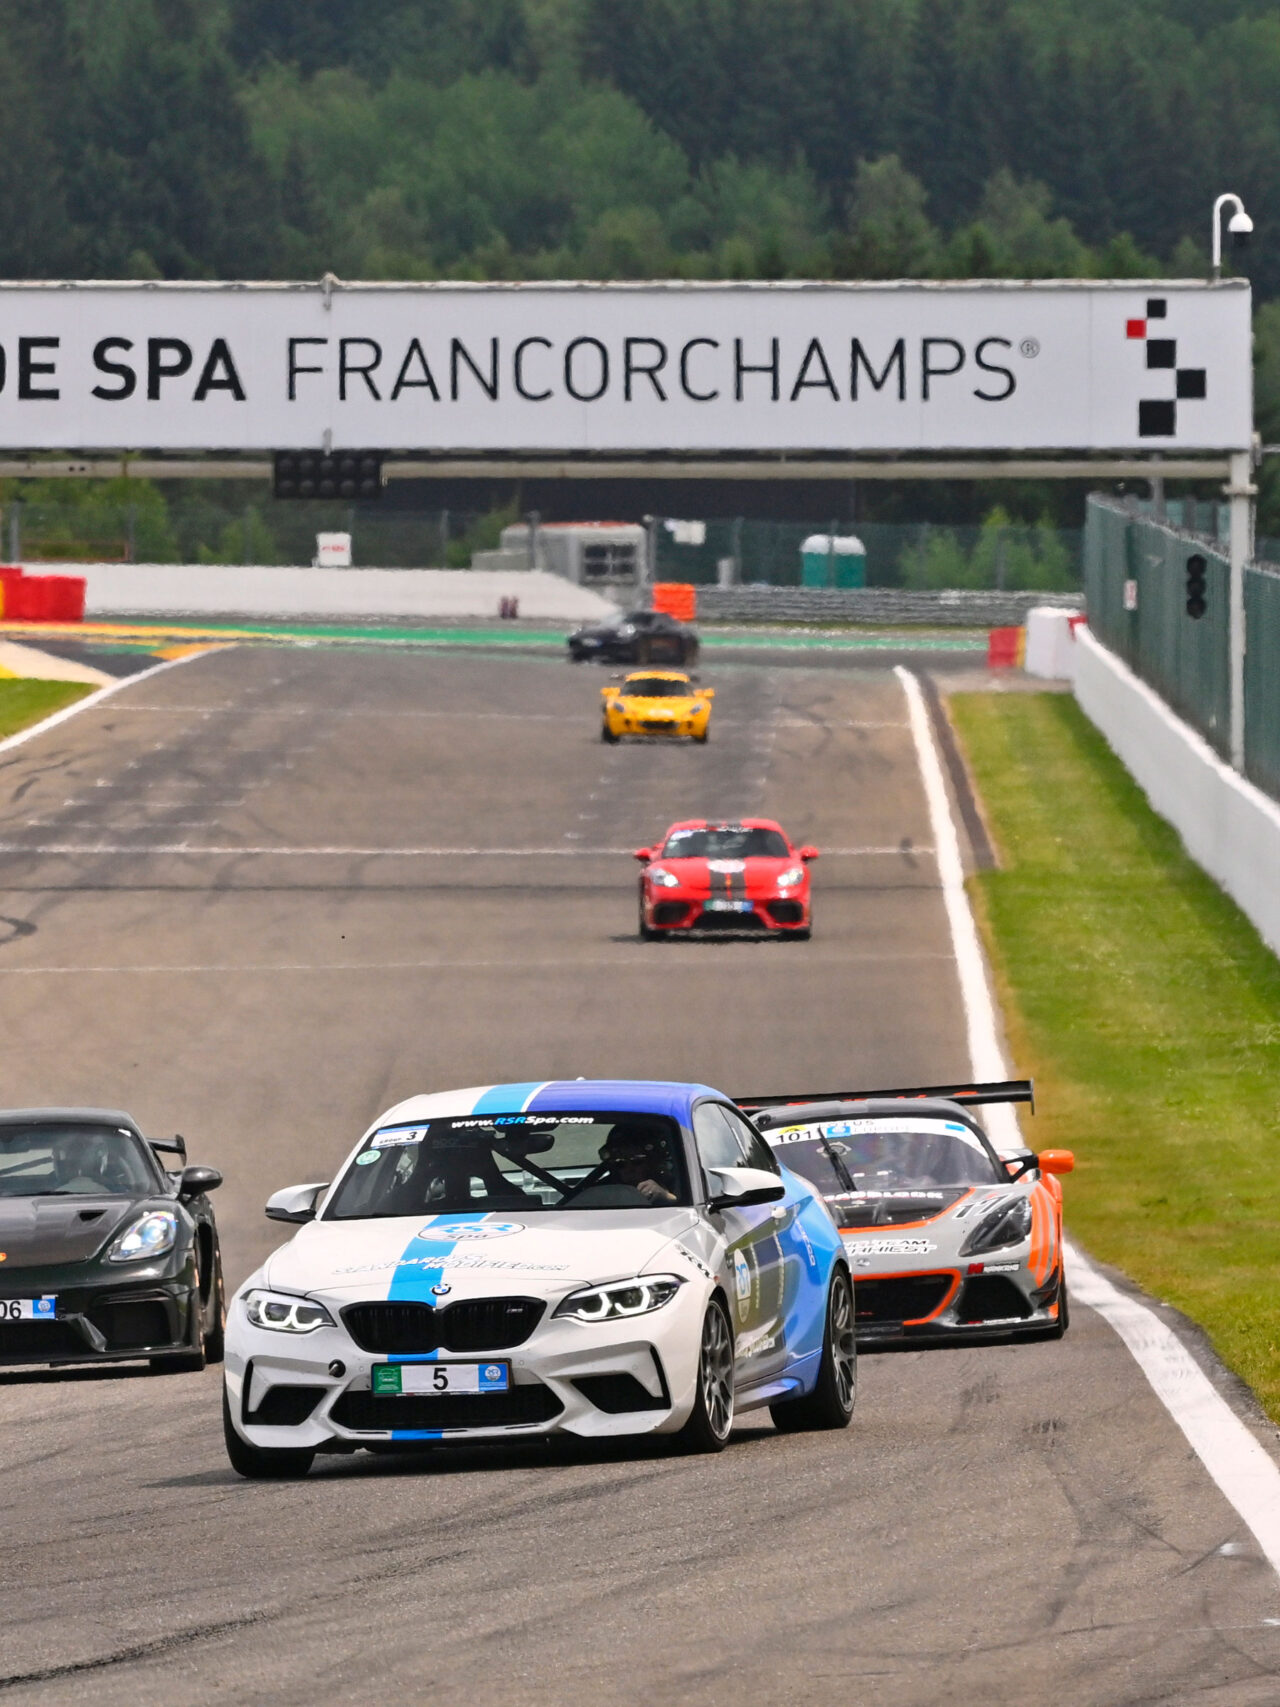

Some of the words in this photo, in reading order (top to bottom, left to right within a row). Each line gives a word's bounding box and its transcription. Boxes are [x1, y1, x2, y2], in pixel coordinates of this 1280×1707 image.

[90, 336, 247, 402] SPA
[451, 1115, 595, 1129] www.RSRSpa.com
[406, 1131, 418, 1141] 3
[776, 1130, 813, 1144] 101
[432, 1367, 449, 1391] 5
